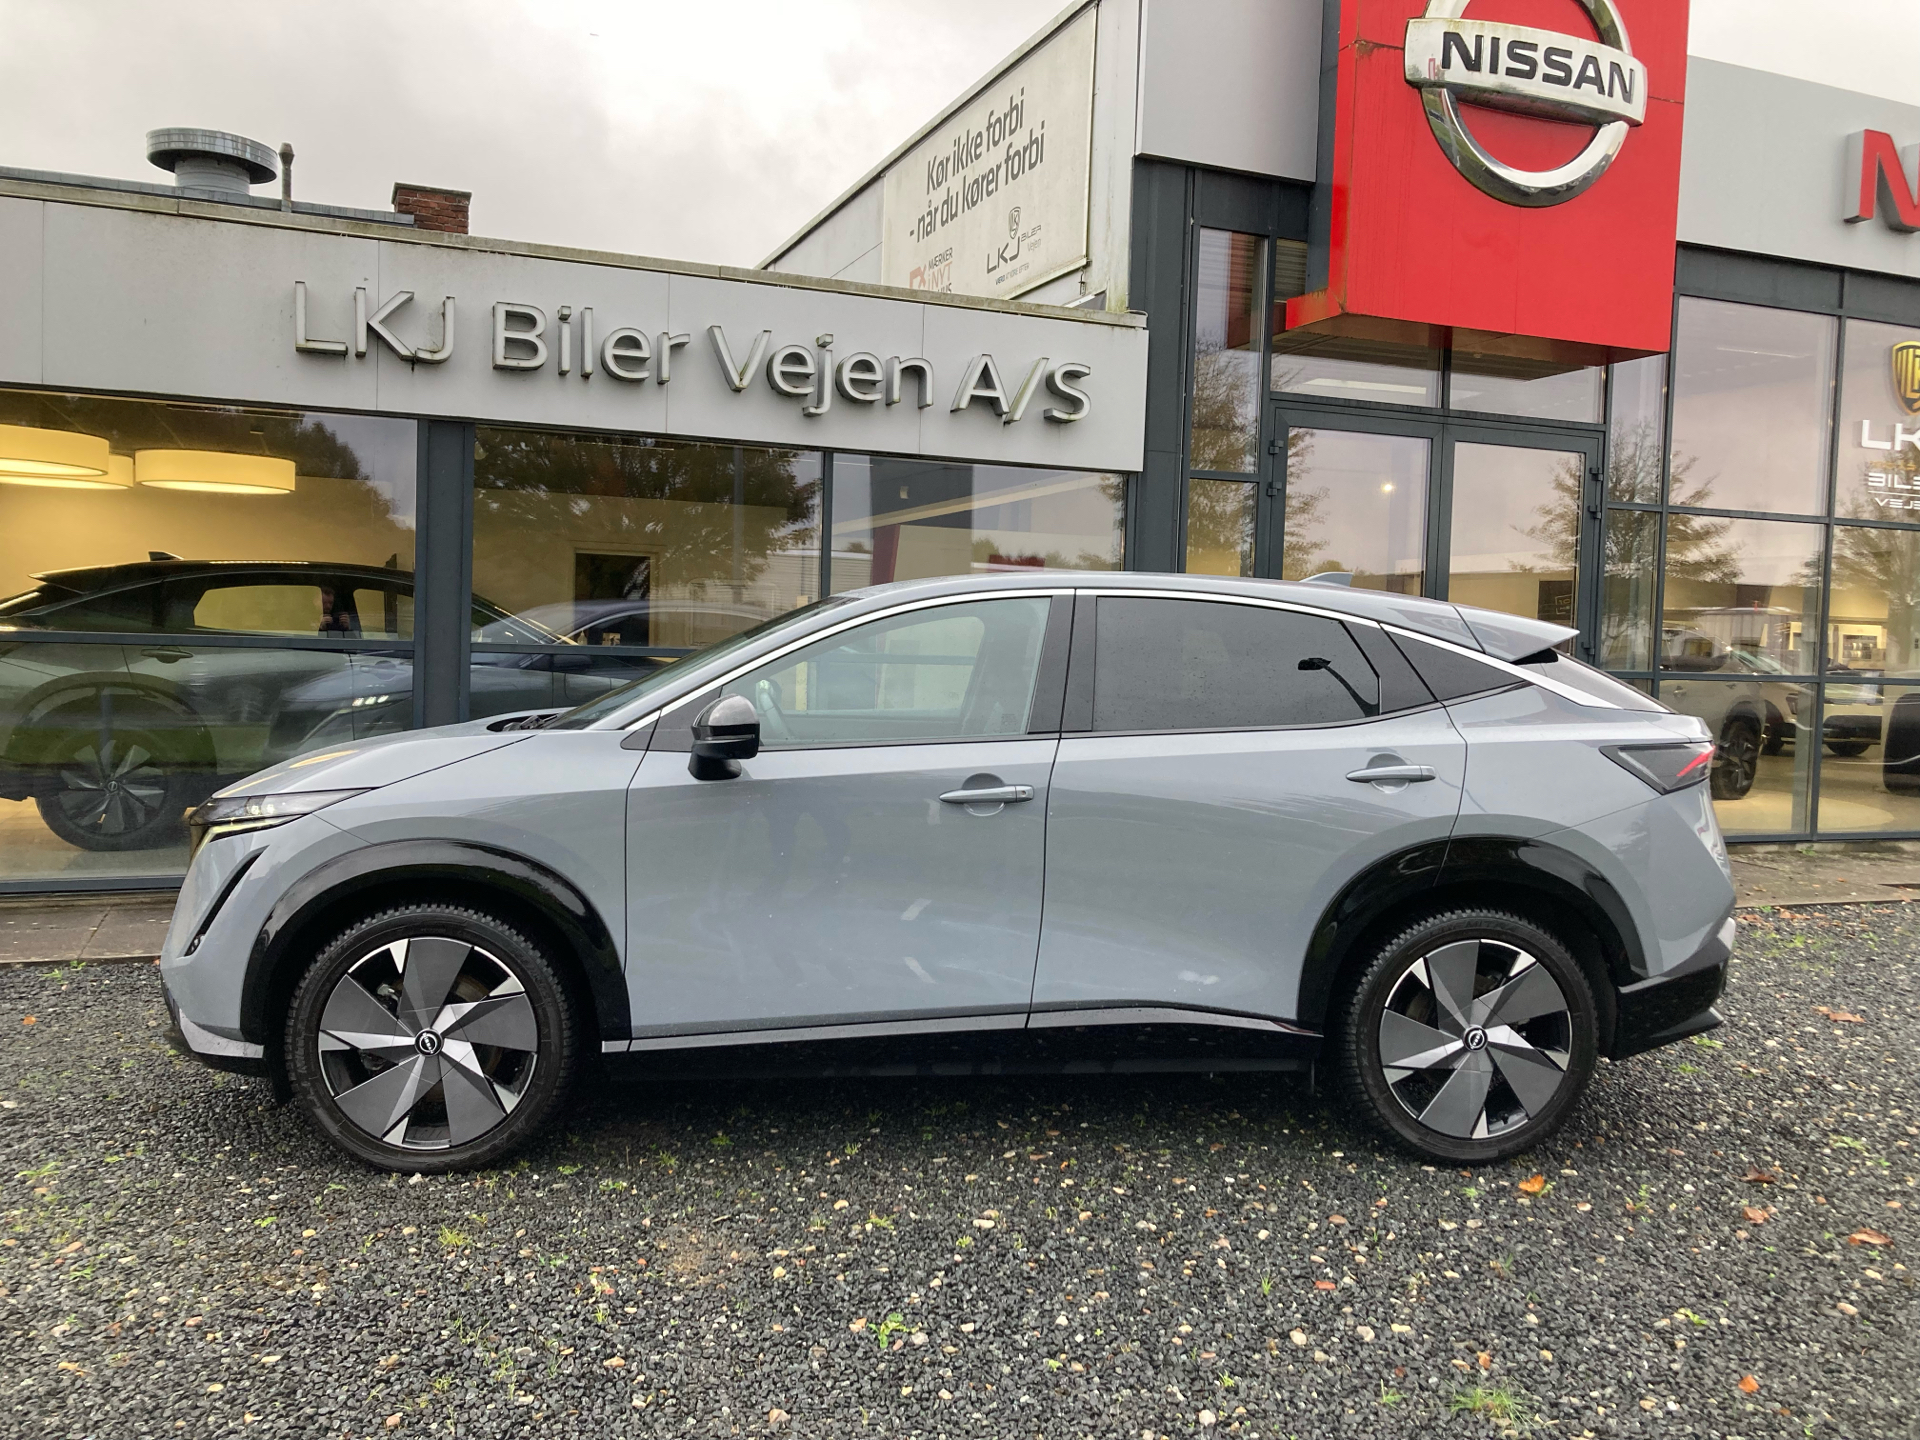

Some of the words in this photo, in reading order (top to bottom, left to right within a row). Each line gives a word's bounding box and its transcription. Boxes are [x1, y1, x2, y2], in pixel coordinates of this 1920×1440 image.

[1441, 31, 1635, 104] NISSAN
[917, 199, 939, 243] når
[940, 186, 959, 227] du
[962, 161, 1002, 214] kører
[1004, 120, 1045, 186] forbi
[926, 155, 951, 195] Kør
[952, 128, 983, 177] ikke
[986, 86, 1025, 153] forbi
[987, 236, 1020, 274] LKJ
[294, 281, 455, 363] LKJ
[493, 301, 690, 384] Biler
[707, 325, 933, 418] Vejen
[951, 353, 1091, 425] A/S
